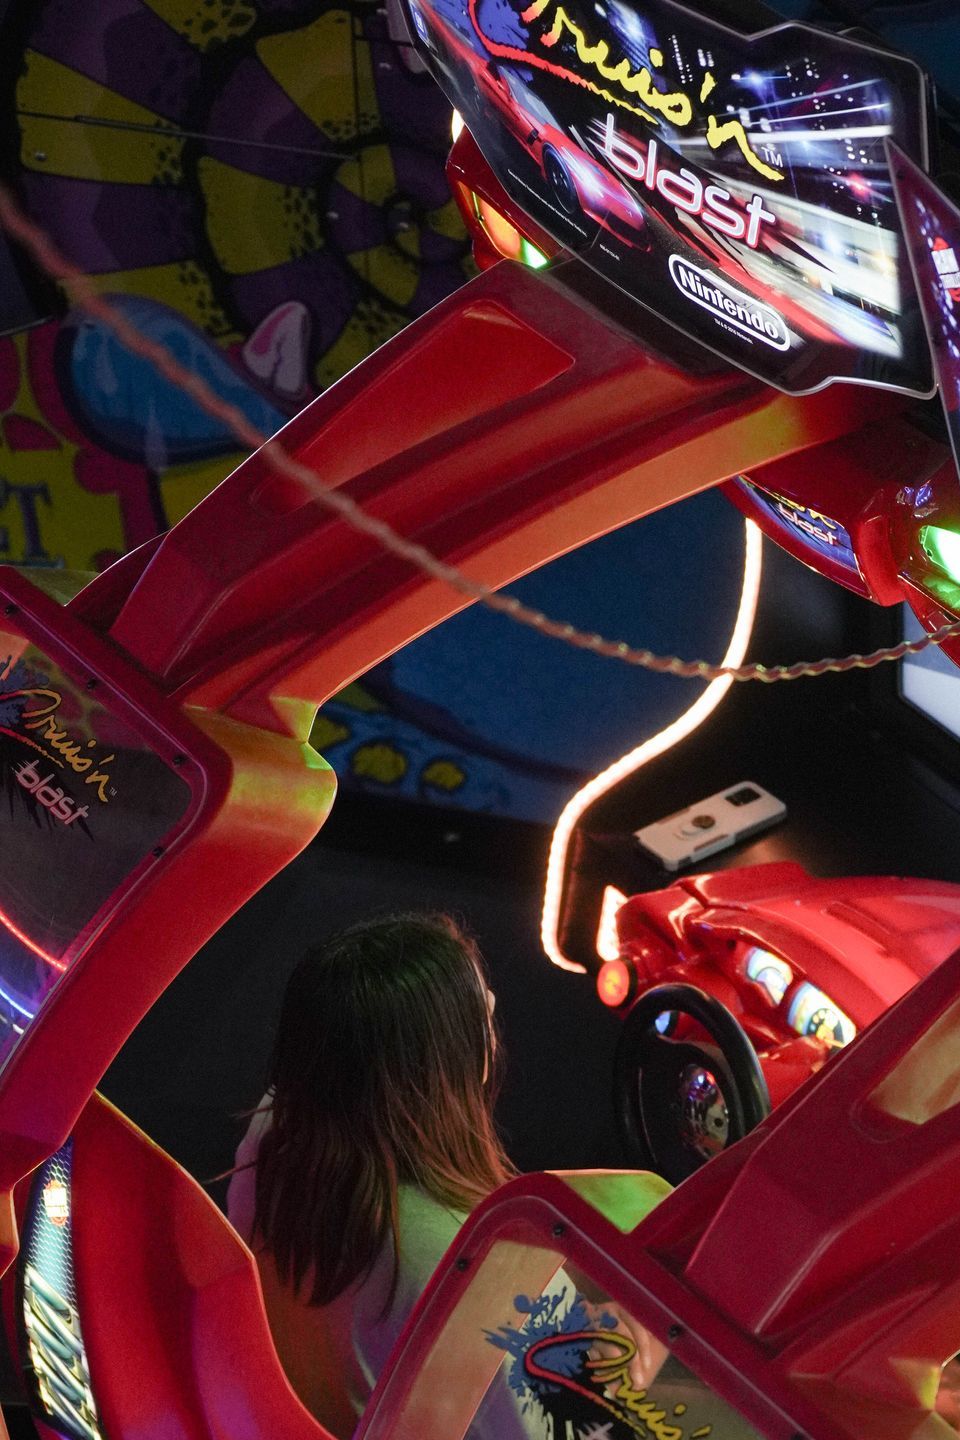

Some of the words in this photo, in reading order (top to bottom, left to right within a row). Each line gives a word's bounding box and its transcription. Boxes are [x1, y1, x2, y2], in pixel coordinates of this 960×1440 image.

[588, 112, 776, 247] blast
[678, 265, 779, 339] Nintendo
[778, 502, 837, 545] blast
[11, 760, 89, 825] blast
